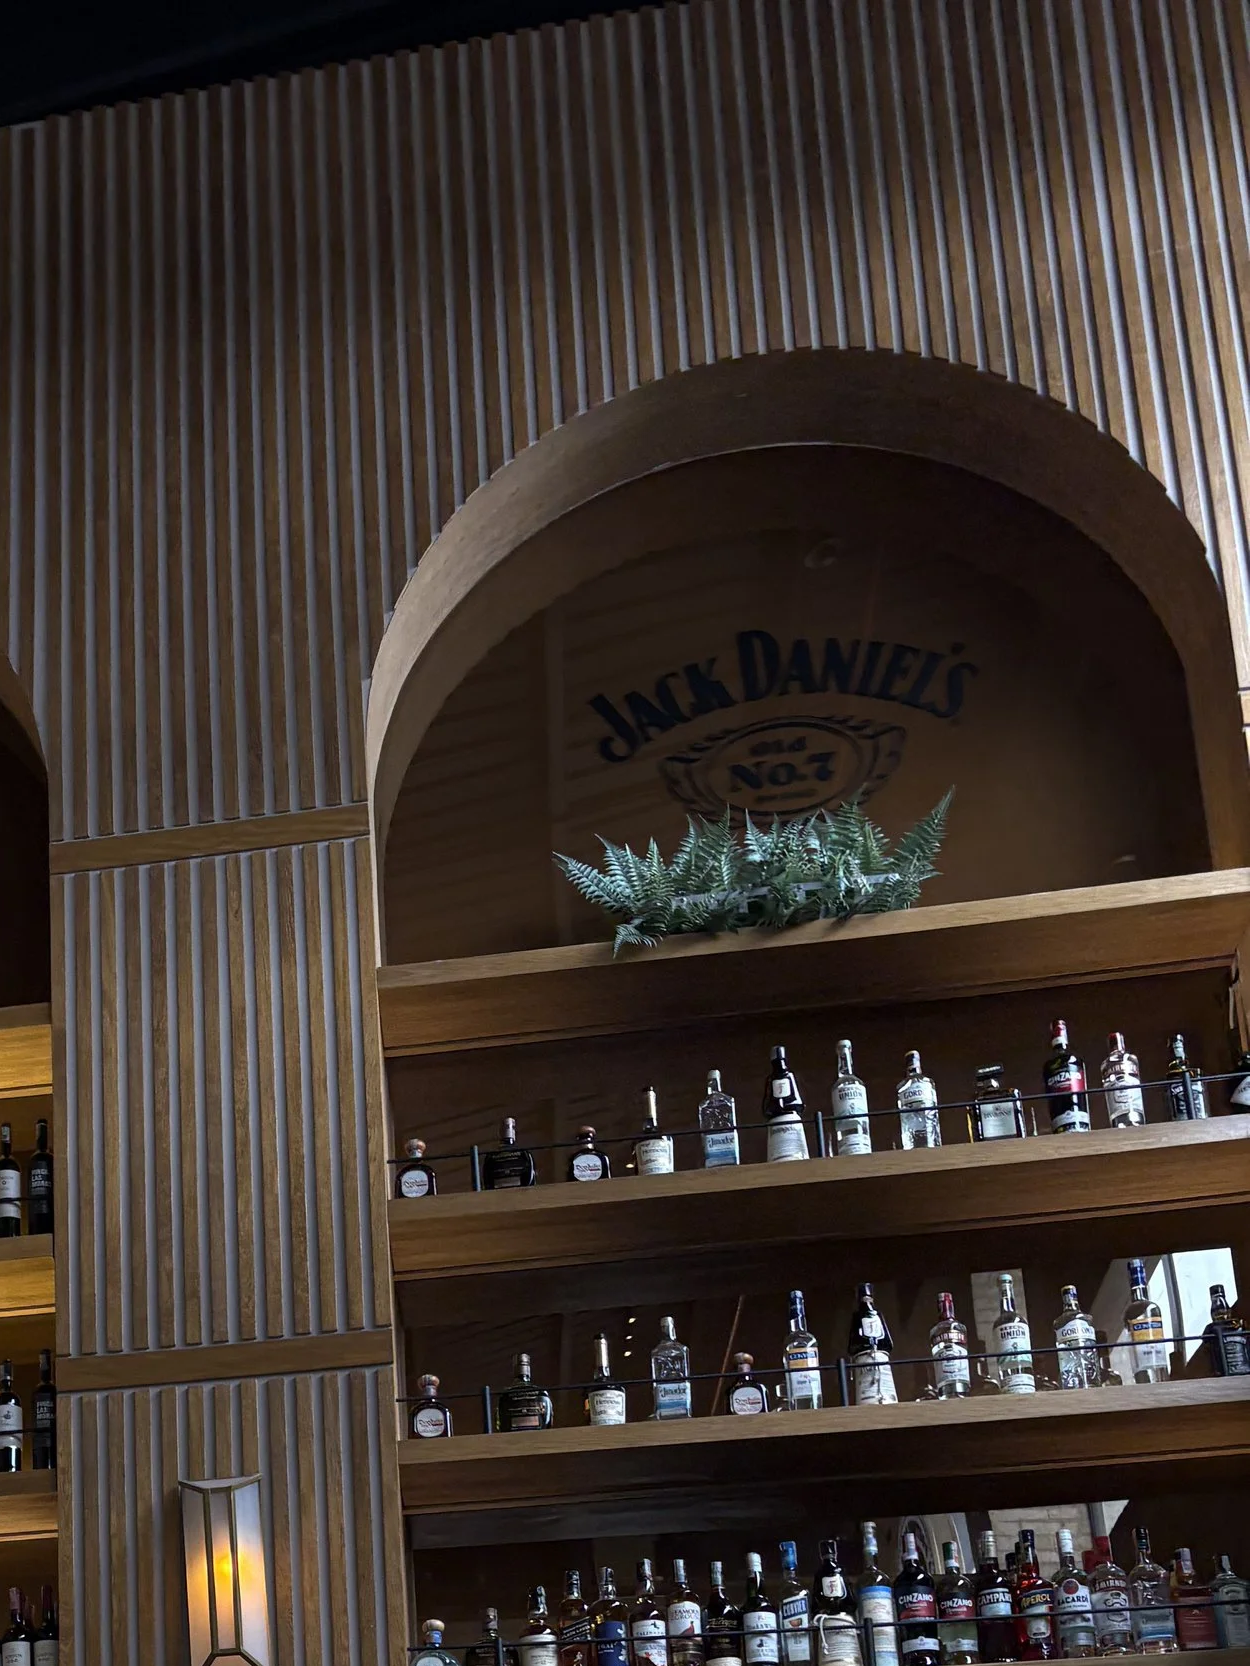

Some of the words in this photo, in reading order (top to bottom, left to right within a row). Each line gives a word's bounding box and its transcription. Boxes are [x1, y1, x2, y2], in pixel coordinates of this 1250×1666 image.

[587, 656, 740, 763] JACK
[736, 629, 981, 719] DANIEL'S
[898, 1592, 934, 1605] CINZANO
[939, 1598, 973, 1609] CINZANO
